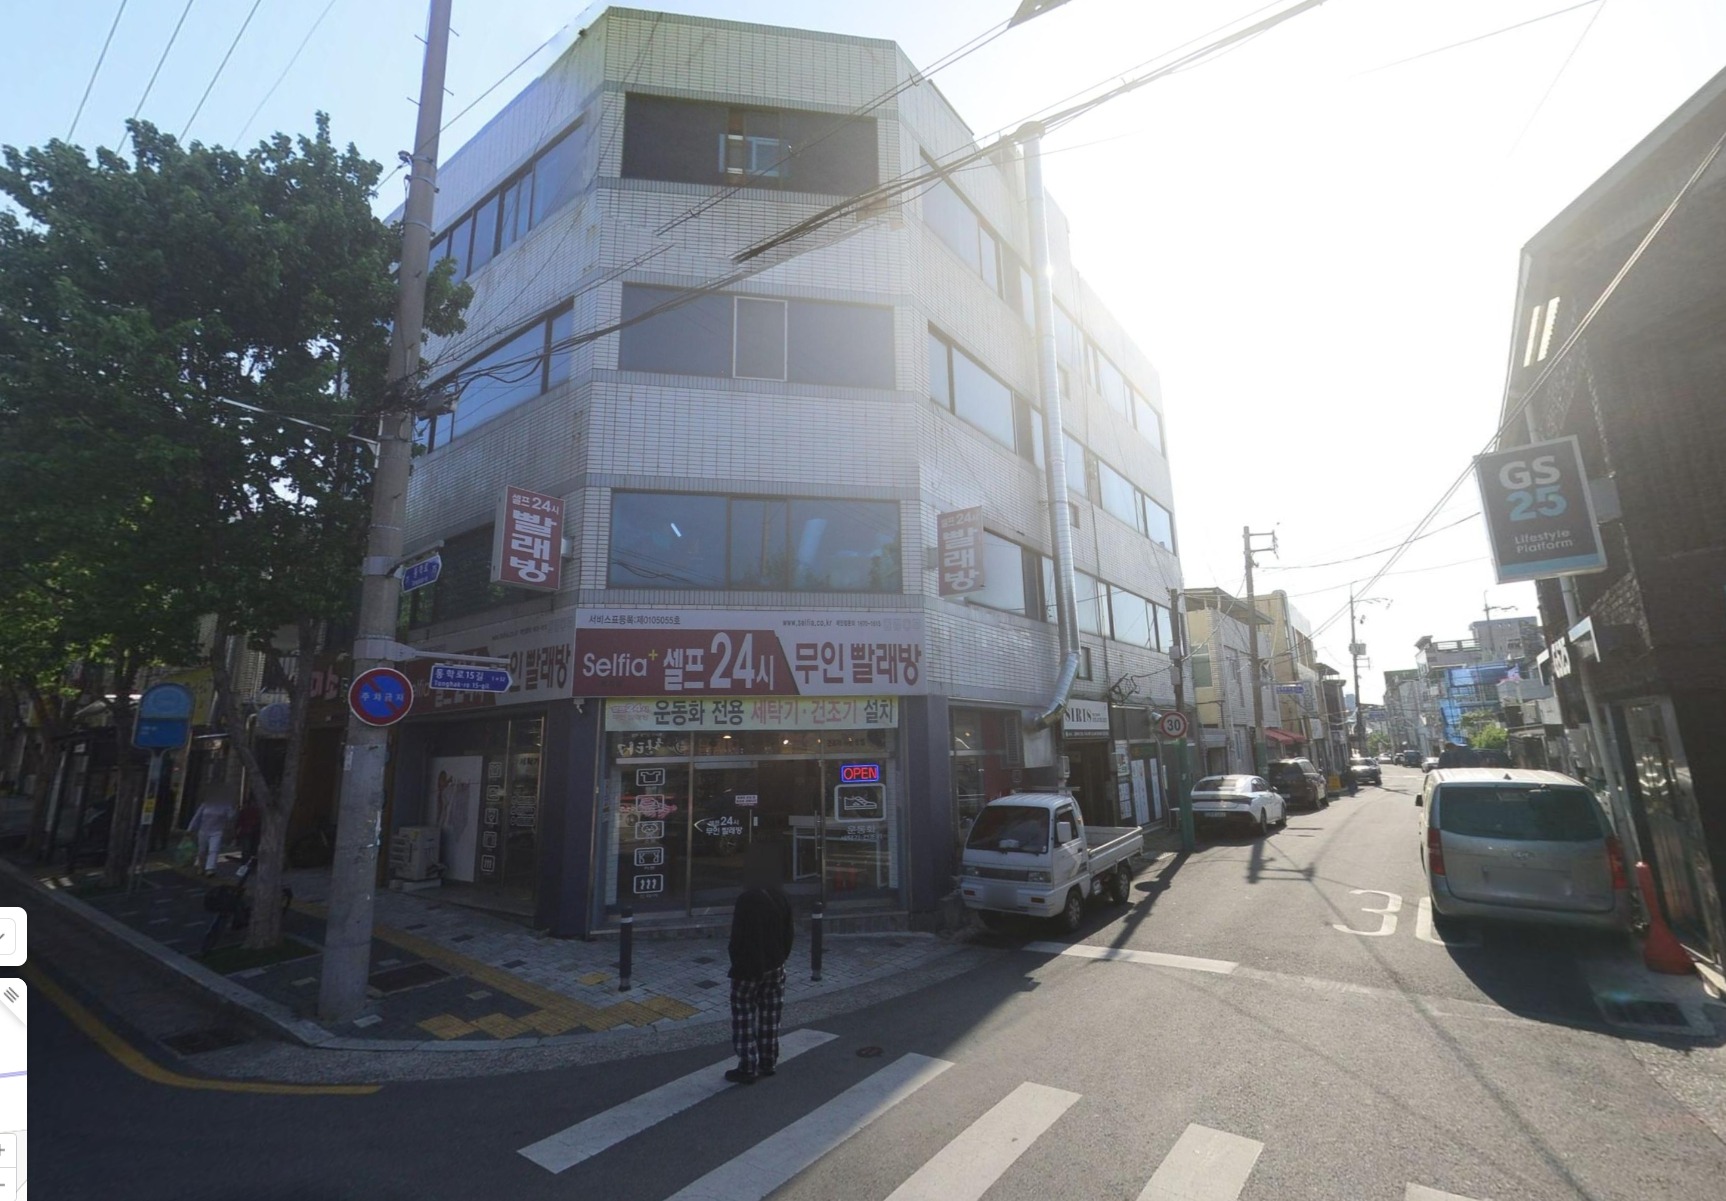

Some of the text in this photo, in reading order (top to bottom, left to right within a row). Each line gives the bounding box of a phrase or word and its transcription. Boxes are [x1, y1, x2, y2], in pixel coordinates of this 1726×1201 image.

[1499, 455, 1561, 490] GS
[1505, 483, 1568, 522] 25
[509, 508, 558, 583] 빨래방
[1514, 529, 1571, 545] Lifestyle
[1516, 538, 1574, 555] Platform
[525, 643, 571, 691] 빨래방
[795, 641, 922, 686] 무인 빨래방
[653, 699, 706, 726] 운동화
[711, 699, 745, 726] 전용
[863, 698, 893, 724] 설치
[1167, 719, 1181, 731] 30
[843, 767, 877, 780] OPEN
